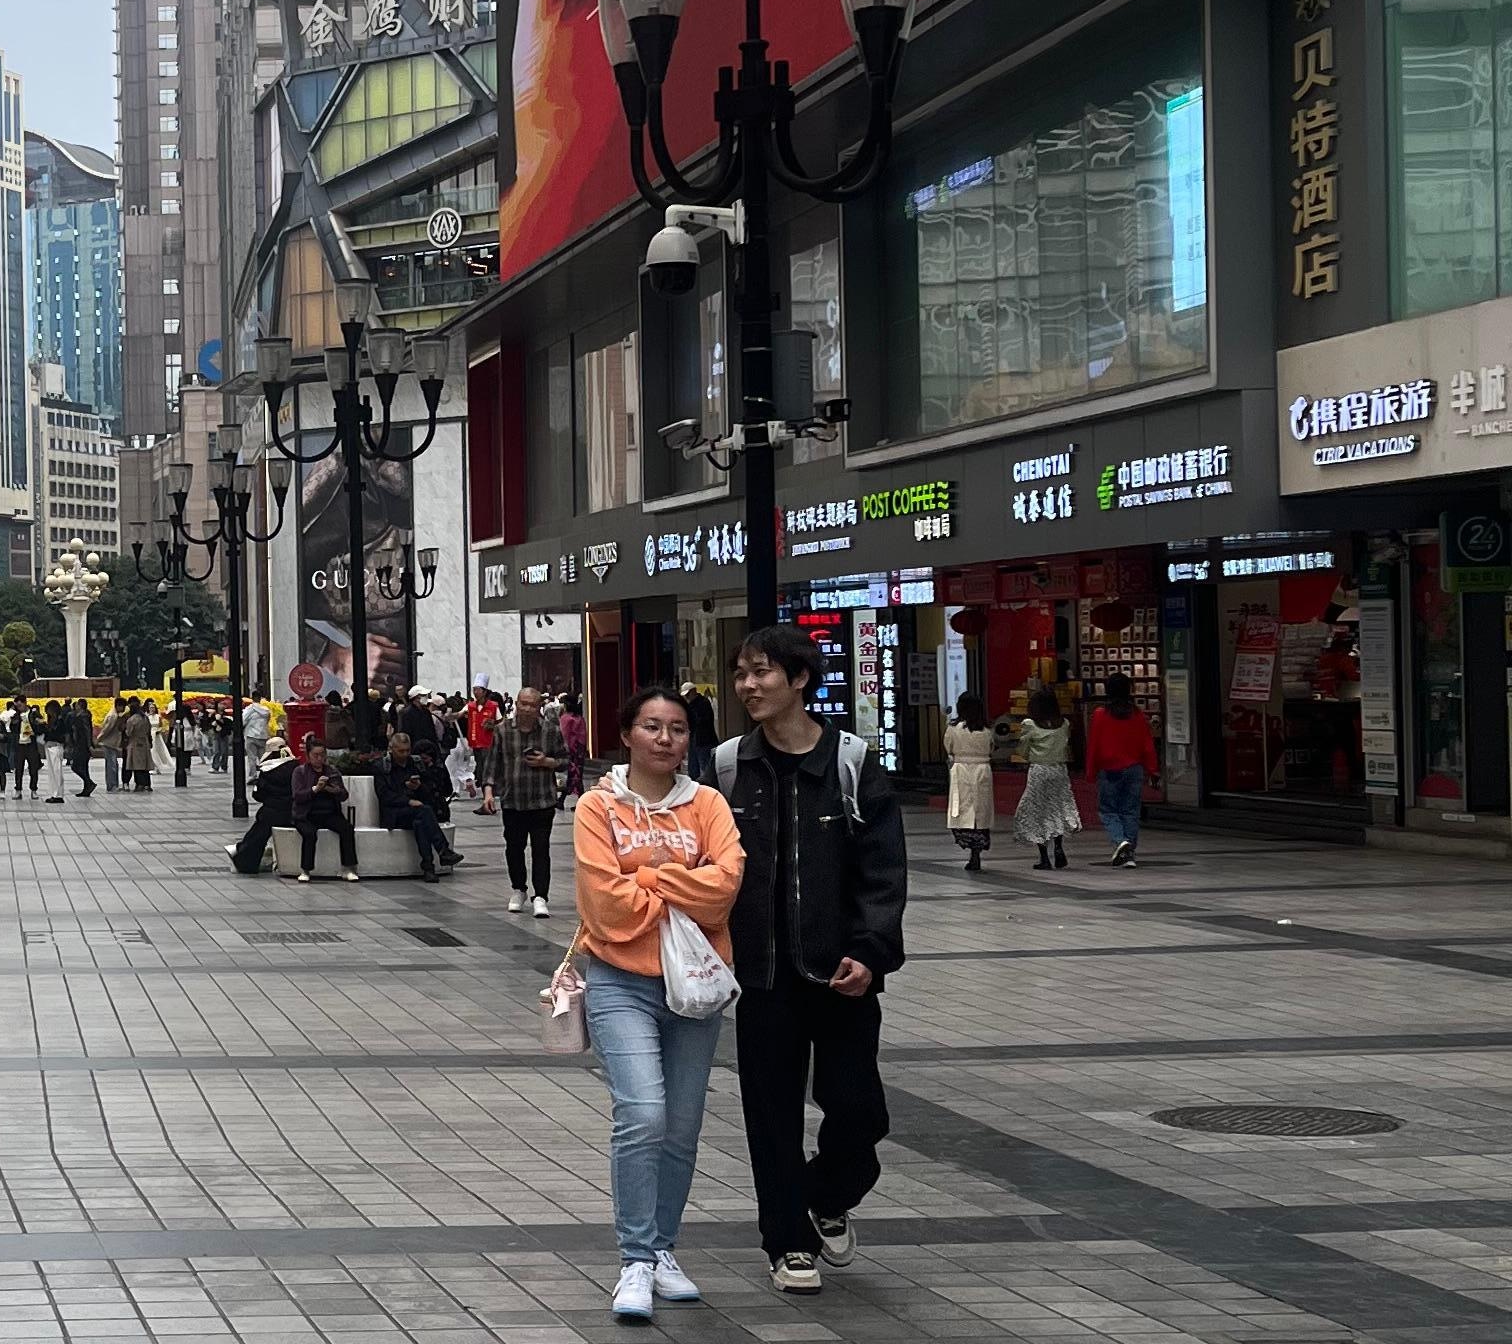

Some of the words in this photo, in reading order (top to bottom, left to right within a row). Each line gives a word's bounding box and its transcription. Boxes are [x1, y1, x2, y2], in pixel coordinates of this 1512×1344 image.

[1291, 26, 1338, 300] 贝特酒店
[1310, 379, 1432, 437] 携程旅游
[1013, 453, 1071, 483] CHENGTAI
[1117, 445, 1228, 490] 中国邮政储蓄银行
[1314, 446, 1345, 465] CTRIP
[1347, 435, 1416, 460] VACATIONS
[862, 491, 890, 520] POST
[892, 483, 936, 516] COFFEE
[1013, 484, 1073, 523] 诚泰通信
[1118, 493, 1144, 508] POSTAL
[583, 541, 618, 568] LONGINES
[707, 521, 748, 566] 诚泰通
[484, 564, 507, 598] KFC
[858, 622, 878, 696] 黄金回收
